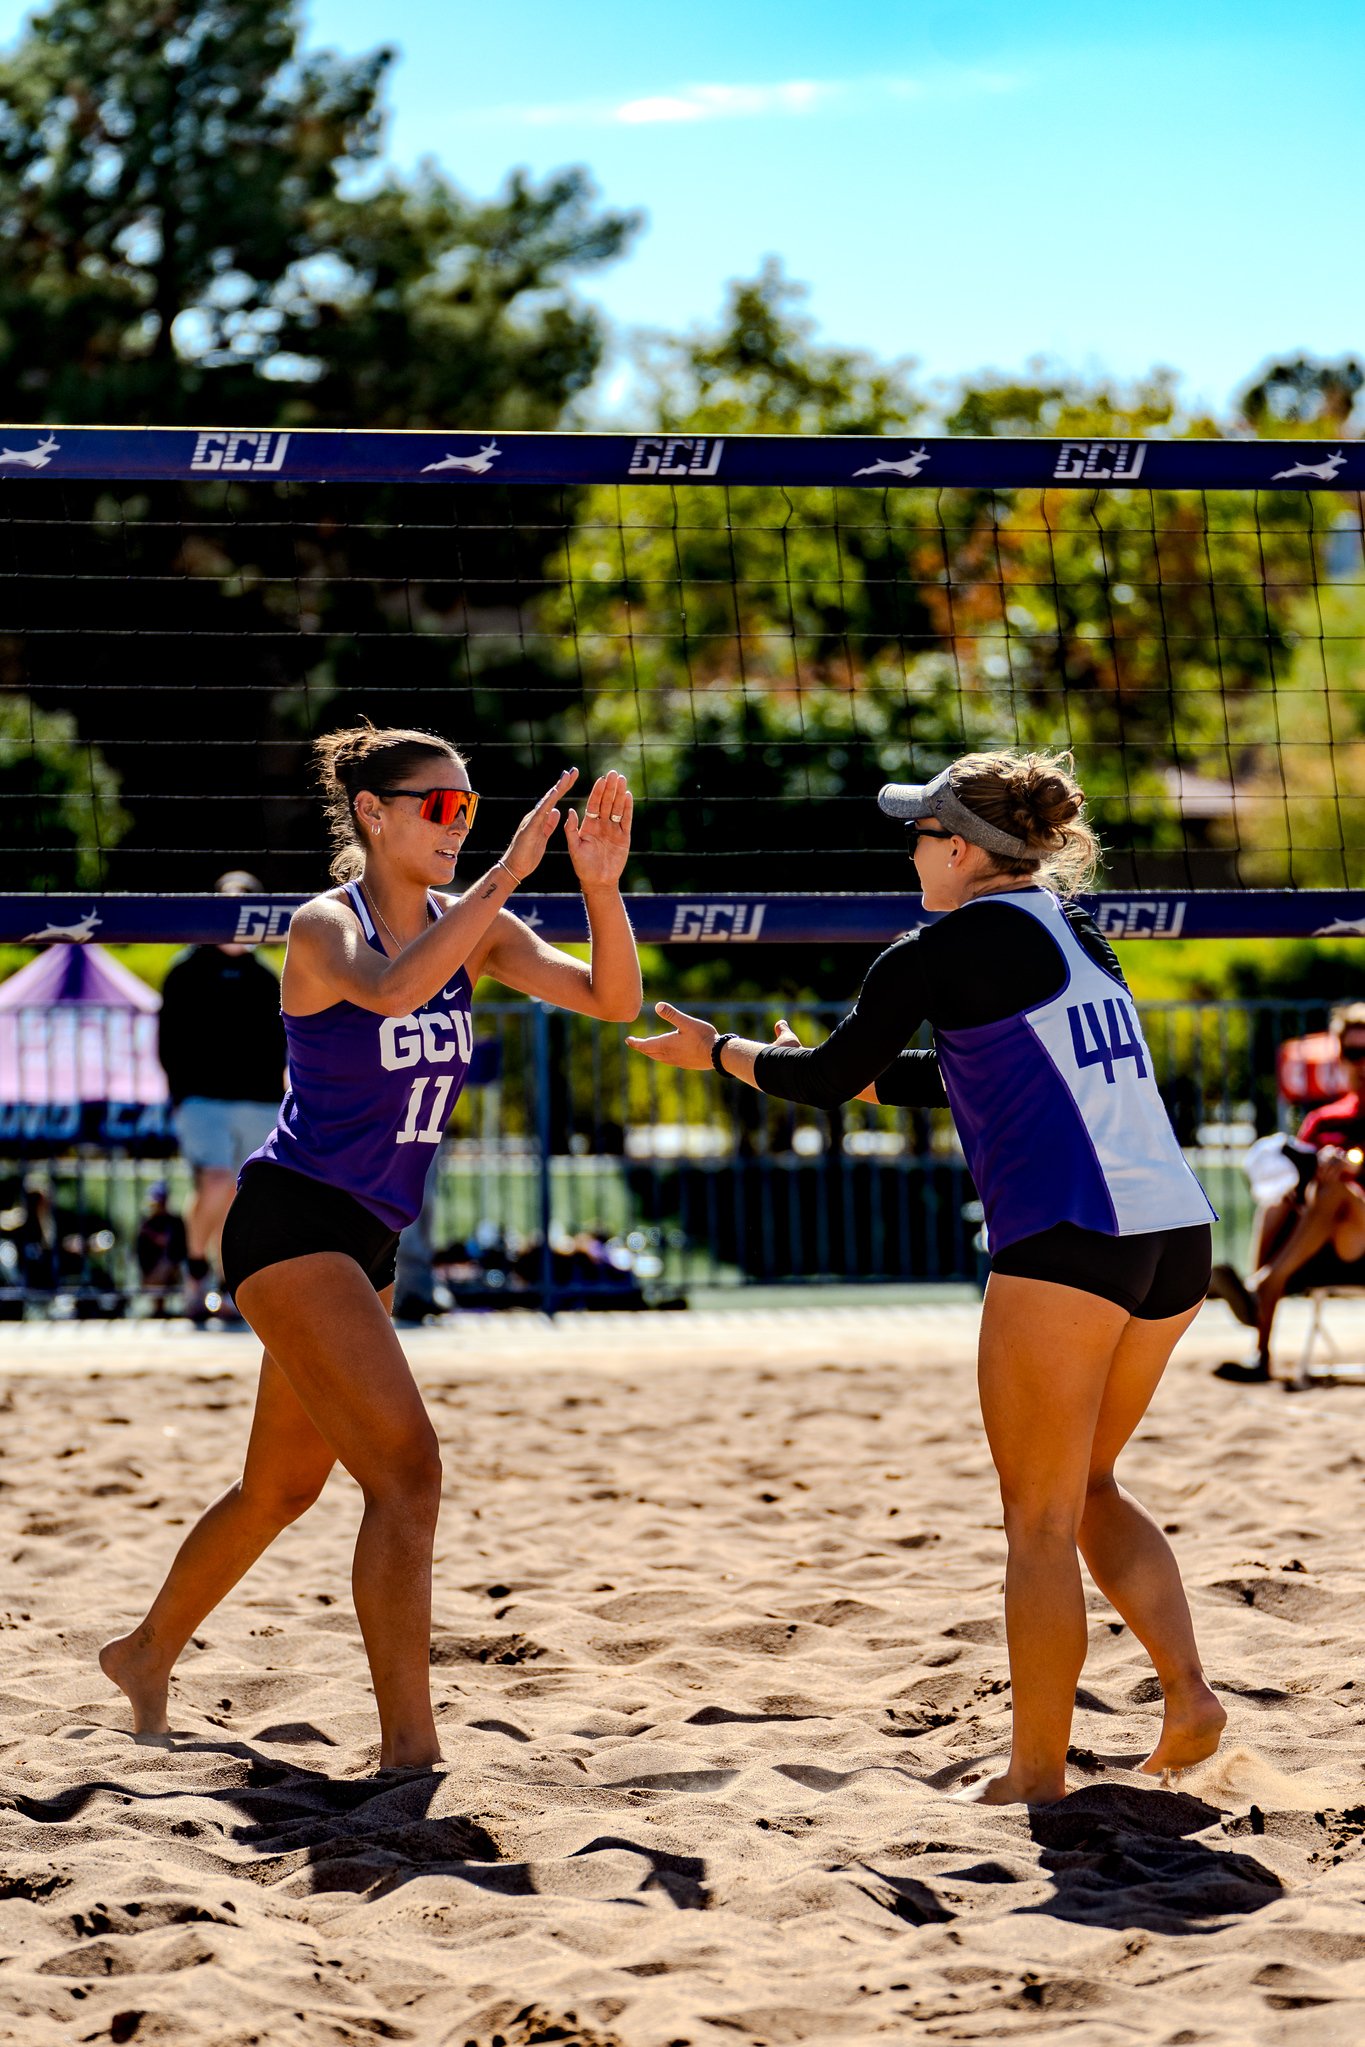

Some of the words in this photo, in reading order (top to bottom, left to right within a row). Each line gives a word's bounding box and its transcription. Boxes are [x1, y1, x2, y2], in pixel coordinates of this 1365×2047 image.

[190, 432, 291, 471] GCU
[628, 438, 724, 475] GCU
[1053, 443, 1147, 479] GCU
[233, 905, 297, 942] GC
[670, 904, 766, 942] GCU
[1097, 902, 1187, 938] GCU
[378, 1010, 473, 1072] GCU
[1066, 998, 1147, 1084] 44
[396, 1075, 454, 1144] 11
